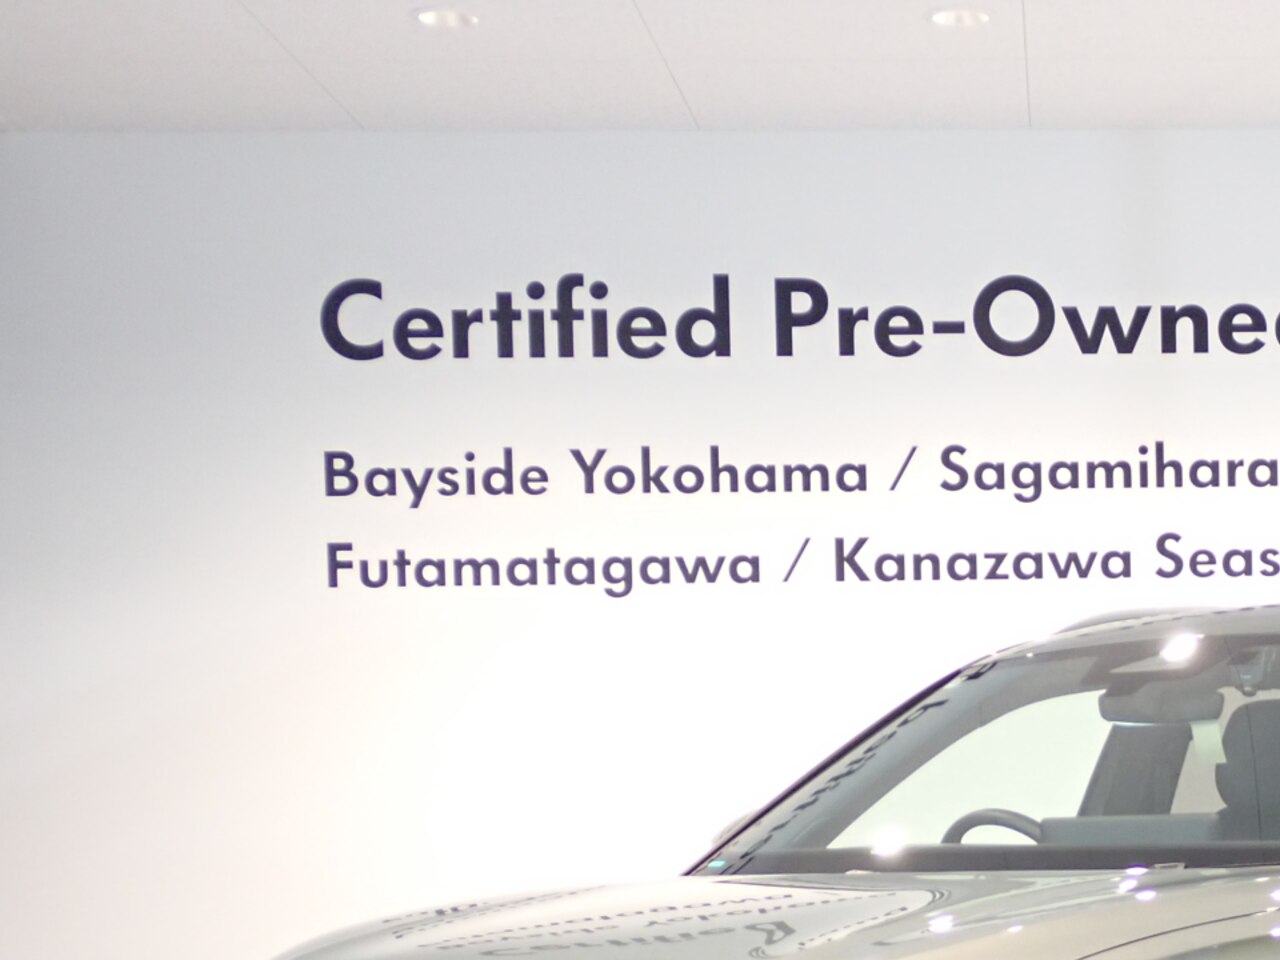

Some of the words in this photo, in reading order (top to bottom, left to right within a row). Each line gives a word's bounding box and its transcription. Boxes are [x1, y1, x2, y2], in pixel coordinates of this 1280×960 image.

[321, 273, 730, 361] Certified
[325, 447, 548, 509] Bayside
[570, 445, 867, 495] Yokohama
[890, 446, 917, 491] /
[940, 441, 1278, 503] Sagamihara
[327, 543, 760, 598] Futamatagawa
[784, 538, 810, 582] /
[835, 537, 1131, 582] Kanazawa
